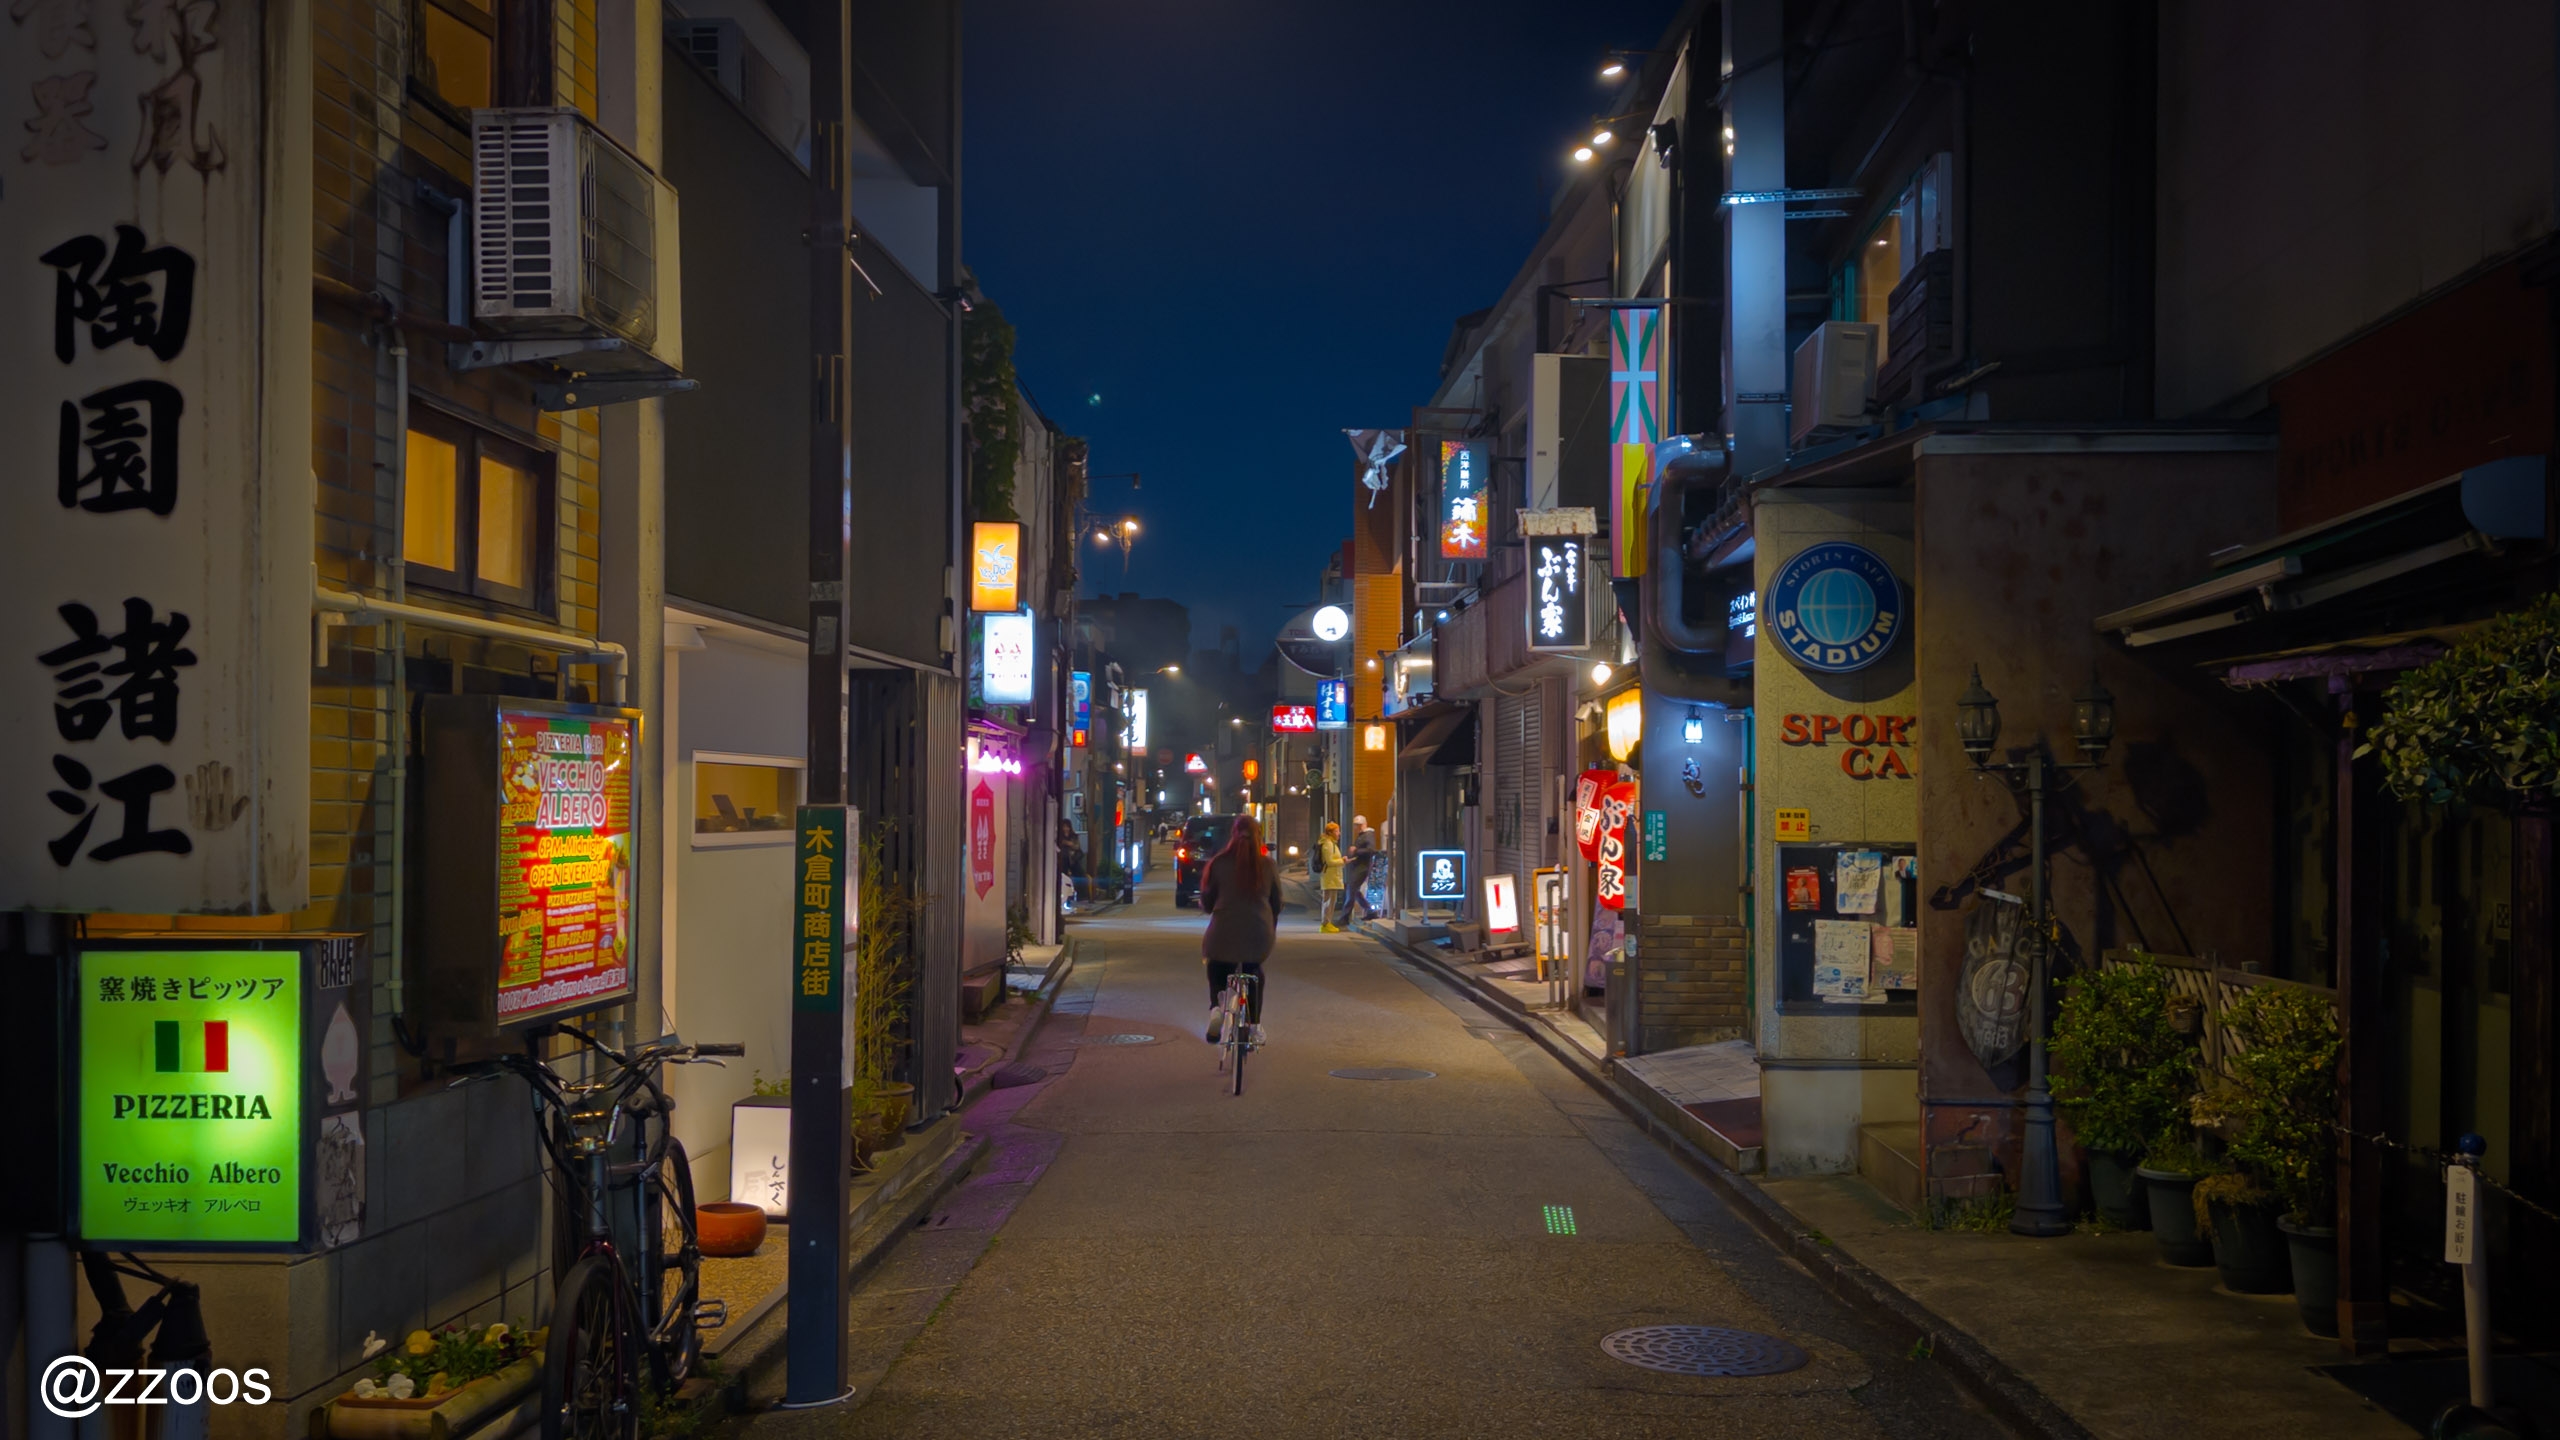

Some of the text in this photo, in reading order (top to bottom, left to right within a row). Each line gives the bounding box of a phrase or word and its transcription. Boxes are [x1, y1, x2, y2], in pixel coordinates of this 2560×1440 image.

[36, 224, 197, 867] 陶園 諸江
[1786, 551, 1842, 587] SPORTS
[1536, 547, 1563, 637] ぶん家
[1779, 609, 1896, 664] STADIUM
[540, 760, 605, 792] VECCHIO
[1841, 746, 1918, 781] CA
[536, 793, 607, 829] ALBERO
[1600, 796, 1625, 896] ぶん家
[529, 863, 562, 888] OPEN
[802, 825, 834, 996] 木倉町商店街
[113, 1094, 272, 1119] PIZZERIA
[103, 1161, 281, 1184] Vecchio Albero
[124, 1197, 191, 1213] ヴェッキオ
